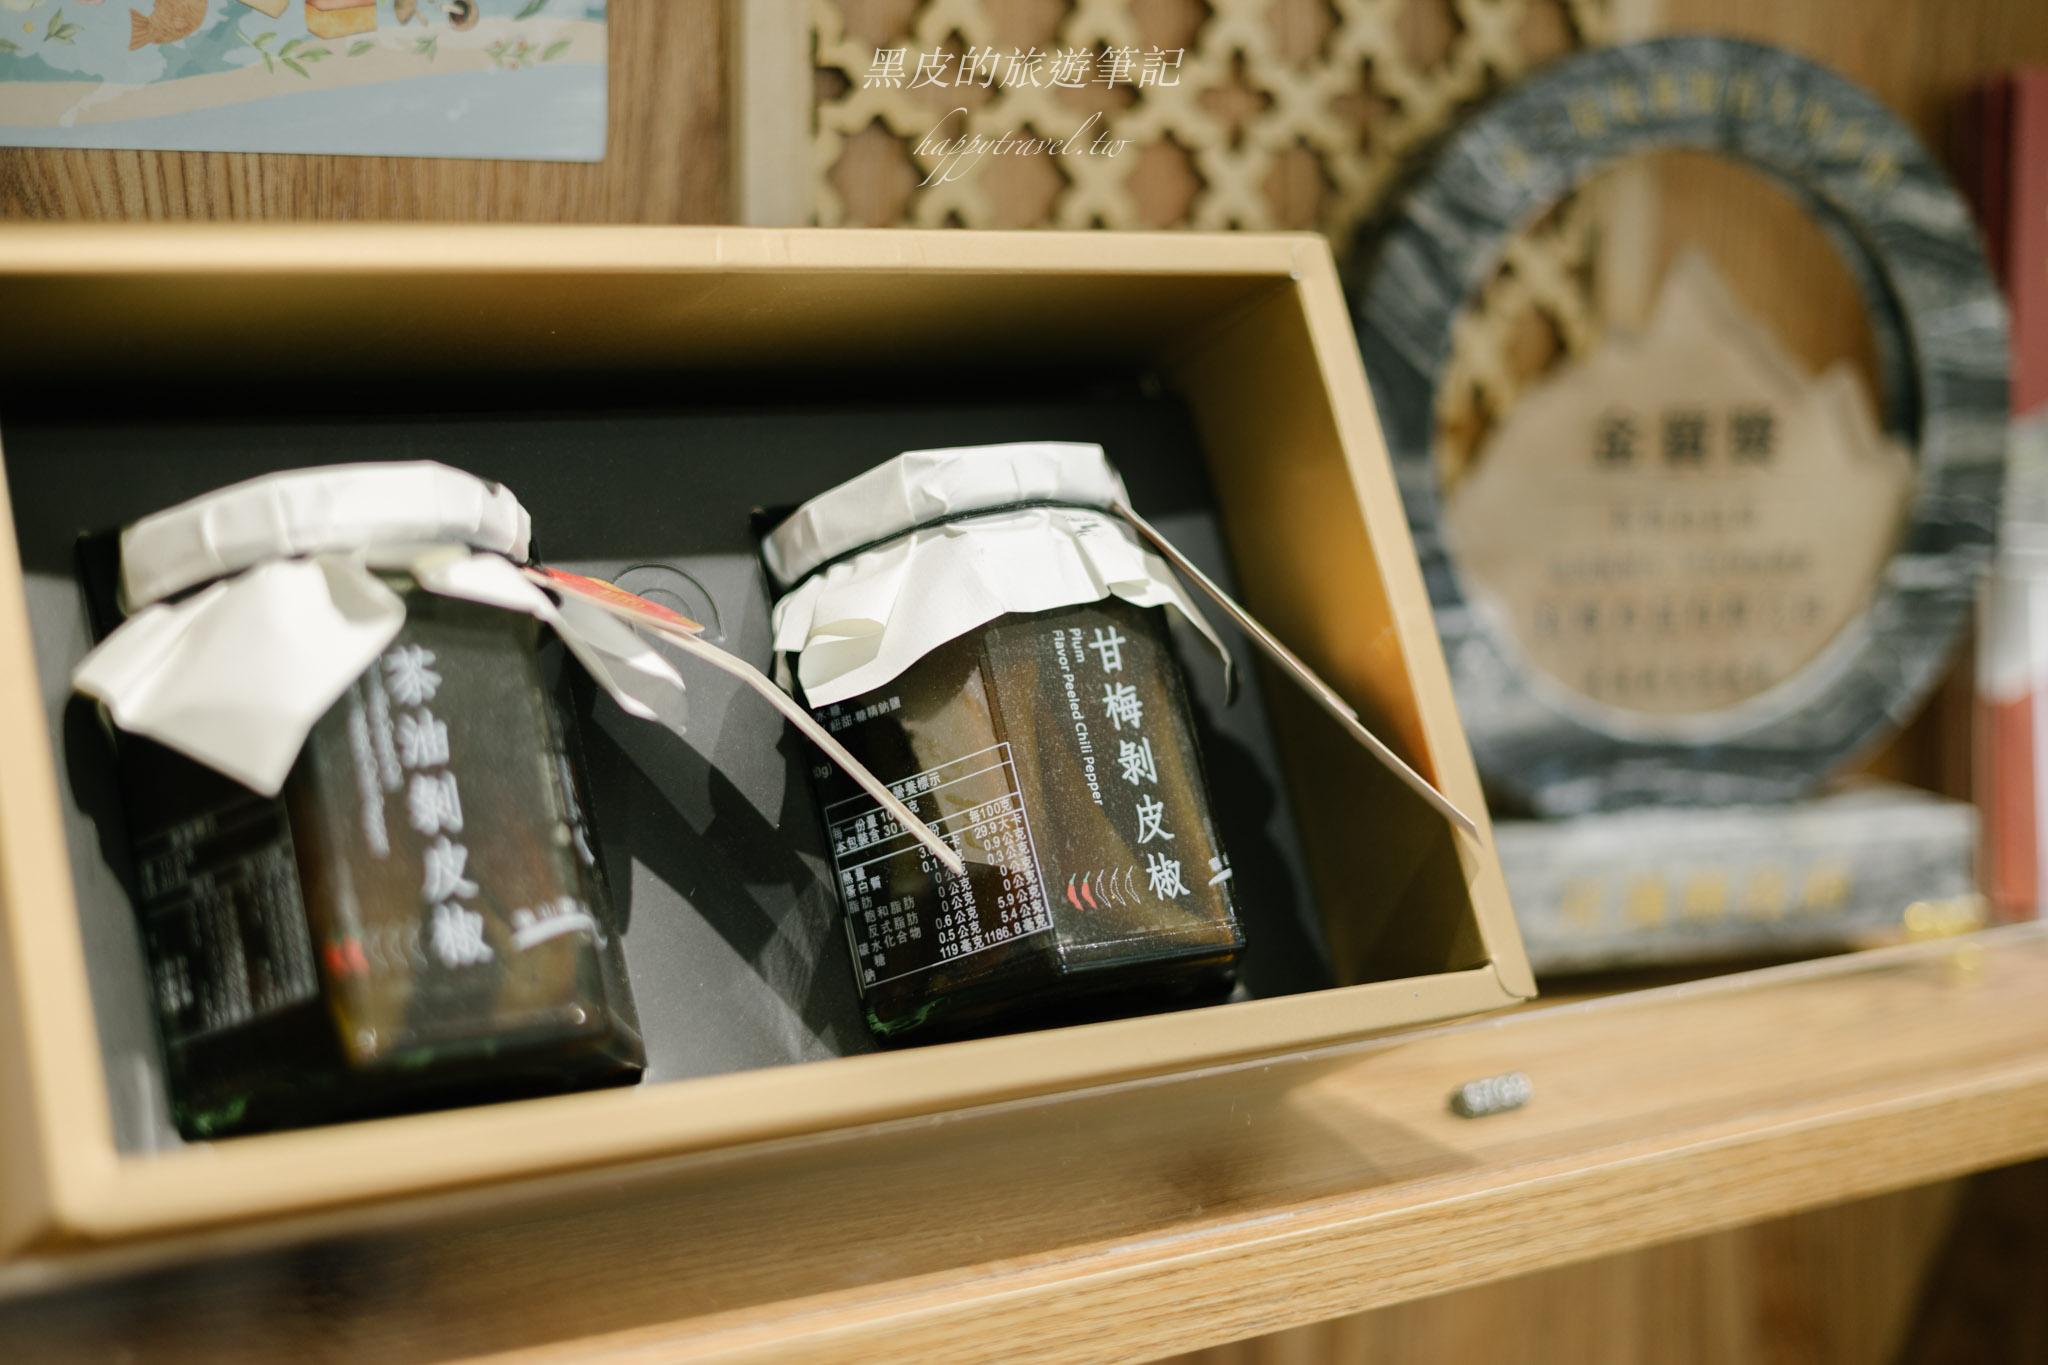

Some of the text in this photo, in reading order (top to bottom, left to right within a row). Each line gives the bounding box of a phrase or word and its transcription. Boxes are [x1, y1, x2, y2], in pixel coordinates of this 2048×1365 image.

[1052, 629, 1104, 806] Flavor Peeled Chili Pepper
[1068, 627, 1085, 663] Plum
[1088, 625, 1191, 901] 甘梅剝皮椒
